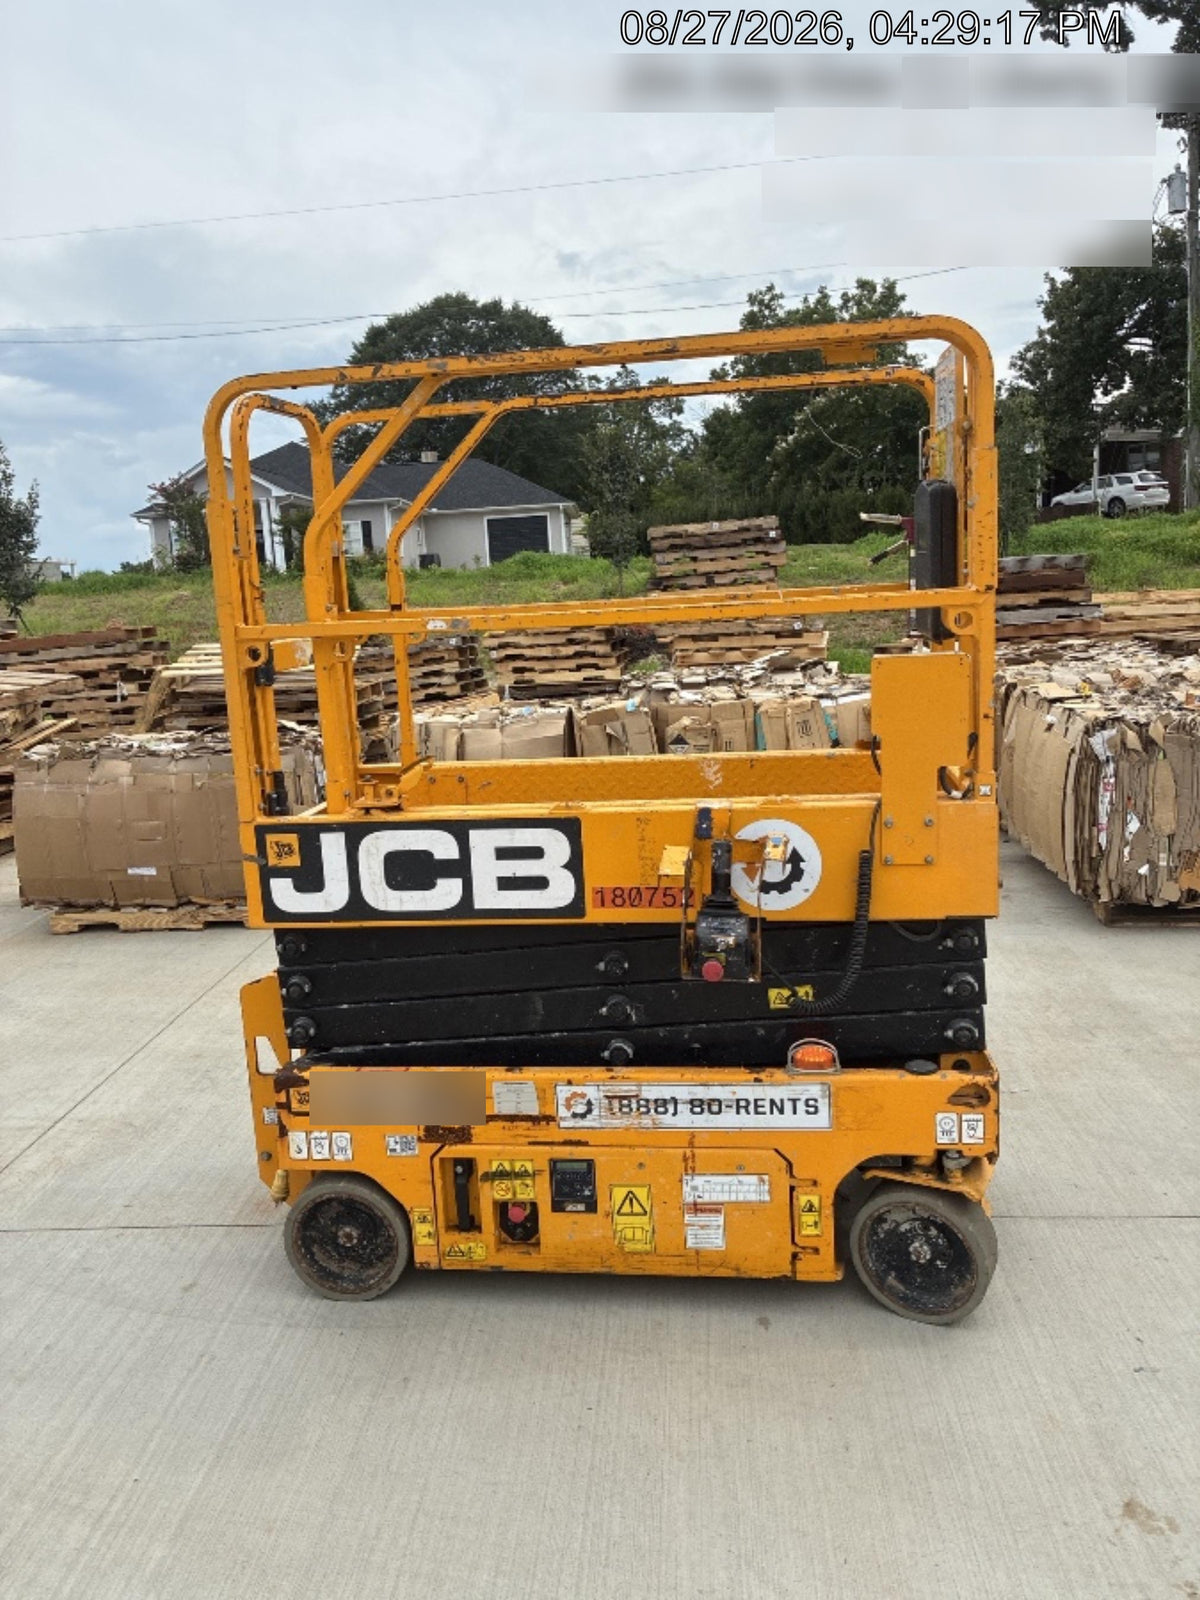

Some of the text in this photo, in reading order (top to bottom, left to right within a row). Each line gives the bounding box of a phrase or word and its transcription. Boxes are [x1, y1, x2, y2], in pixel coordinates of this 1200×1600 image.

[269, 828, 577, 913] JCB
[594, 886, 694, 908] 180752
[689, 1097, 820, 1117] 80-RENTS
